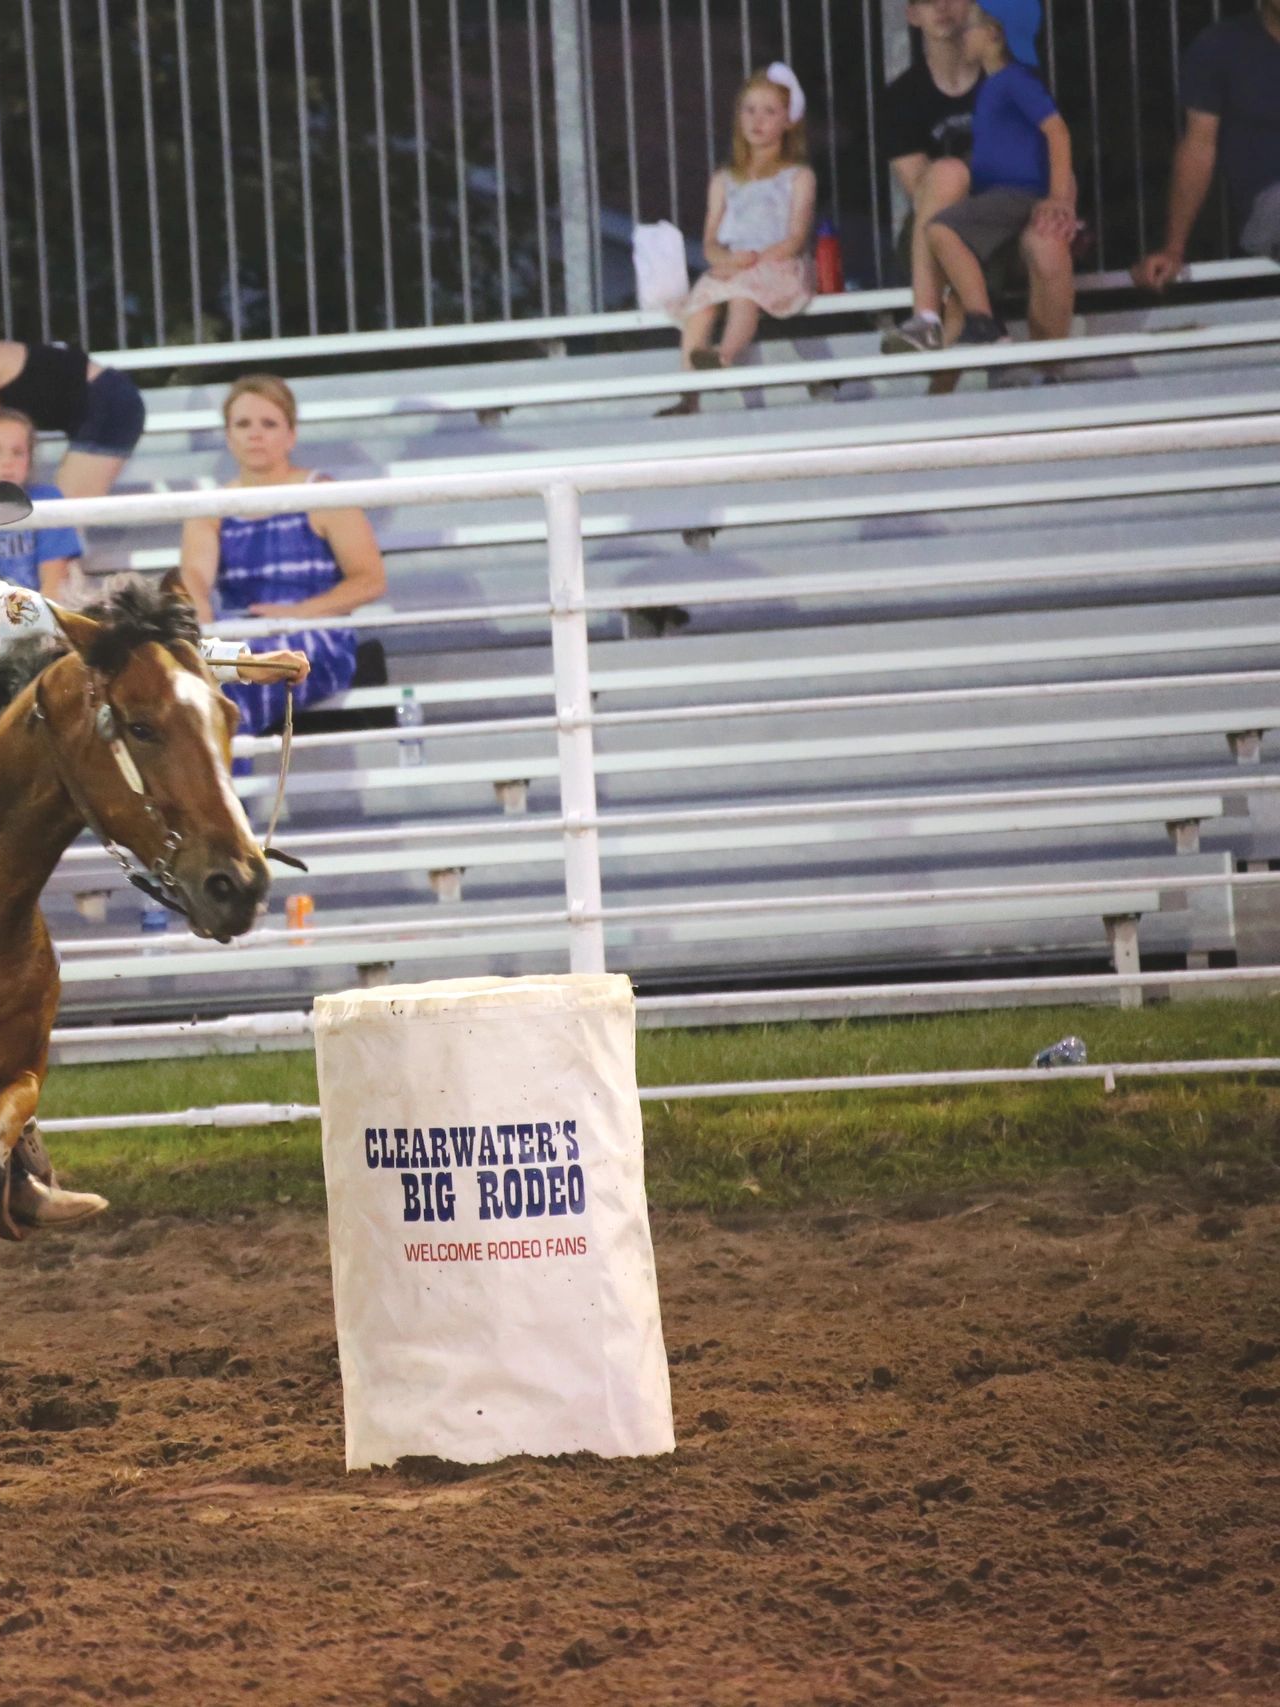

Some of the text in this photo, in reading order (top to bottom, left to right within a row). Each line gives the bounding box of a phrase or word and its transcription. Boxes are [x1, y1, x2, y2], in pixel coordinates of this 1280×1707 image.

[365, 1120, 580, 1169] CLEARWATER'S
[401, 1164, 586, 1222] BIG RODEO
[404, 1236, 587, 1262] WELCOME RODEO FANS
